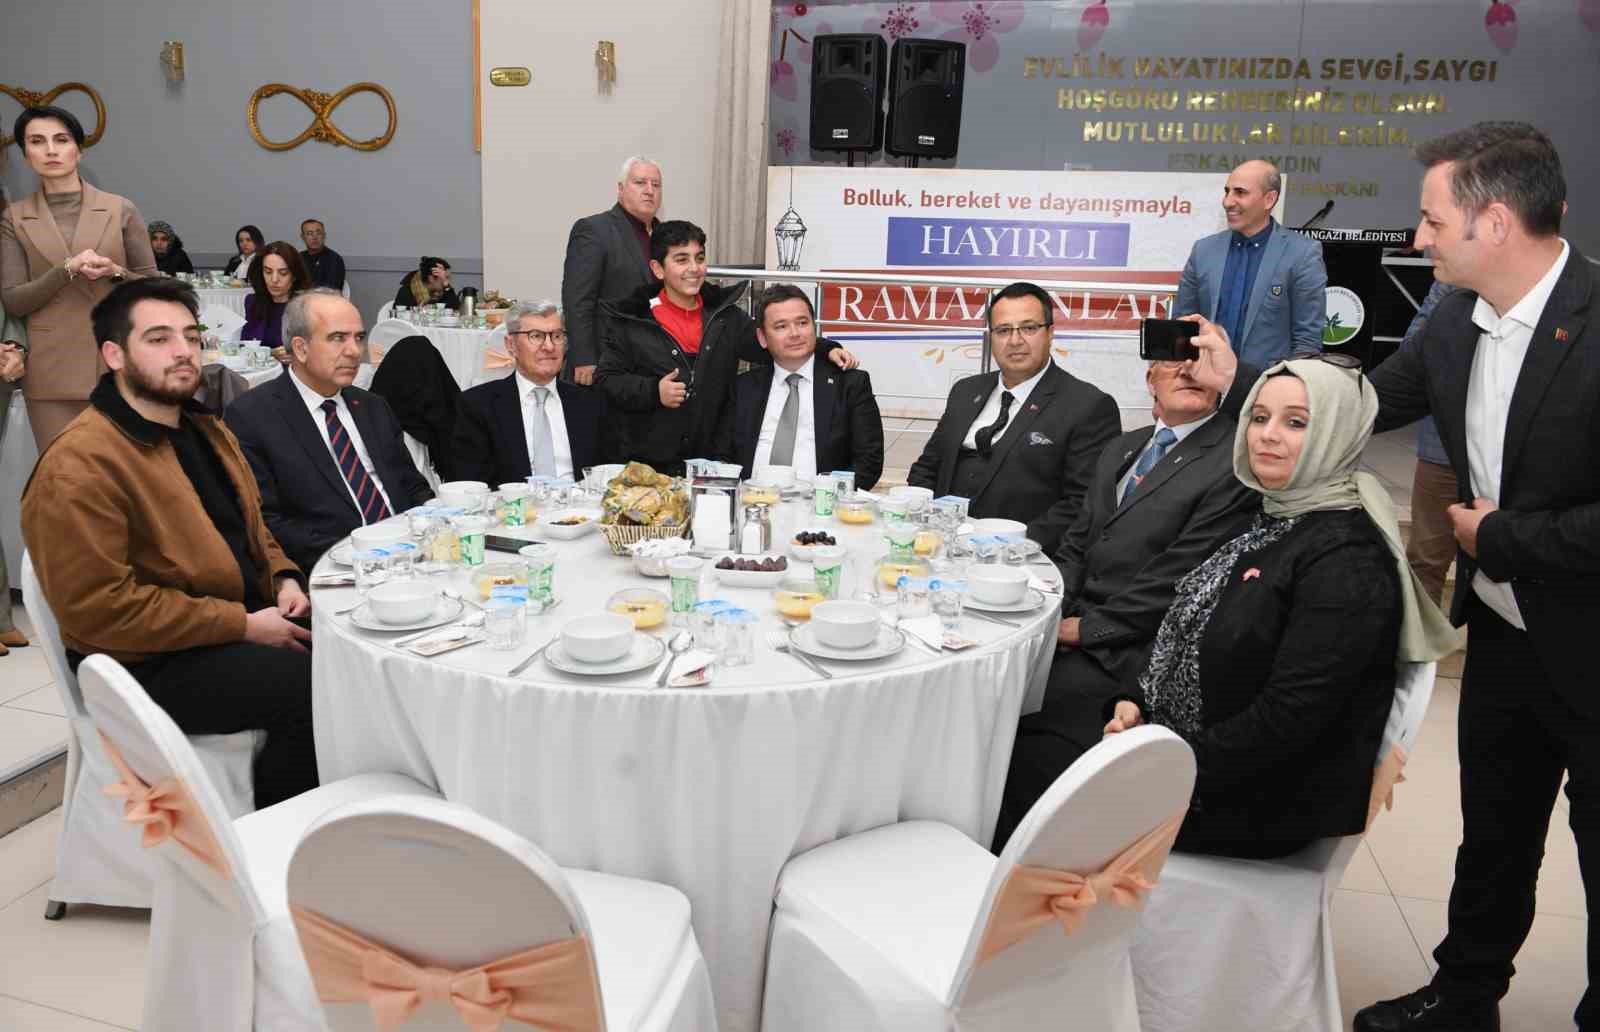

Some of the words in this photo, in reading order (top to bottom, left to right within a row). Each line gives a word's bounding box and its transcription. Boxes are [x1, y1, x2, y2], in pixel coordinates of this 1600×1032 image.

[1135, 57, 1313, 81] HAYATINIZDA
[843, 188, 912, 208] Bolluk,
[920, 190, 1001, 209] bereket
[1008, 196, 1032, 209] ve
[1039, 192, 1192, 217] dayanışmayla
[920, 224, 1100, 260] HAYIRLI
